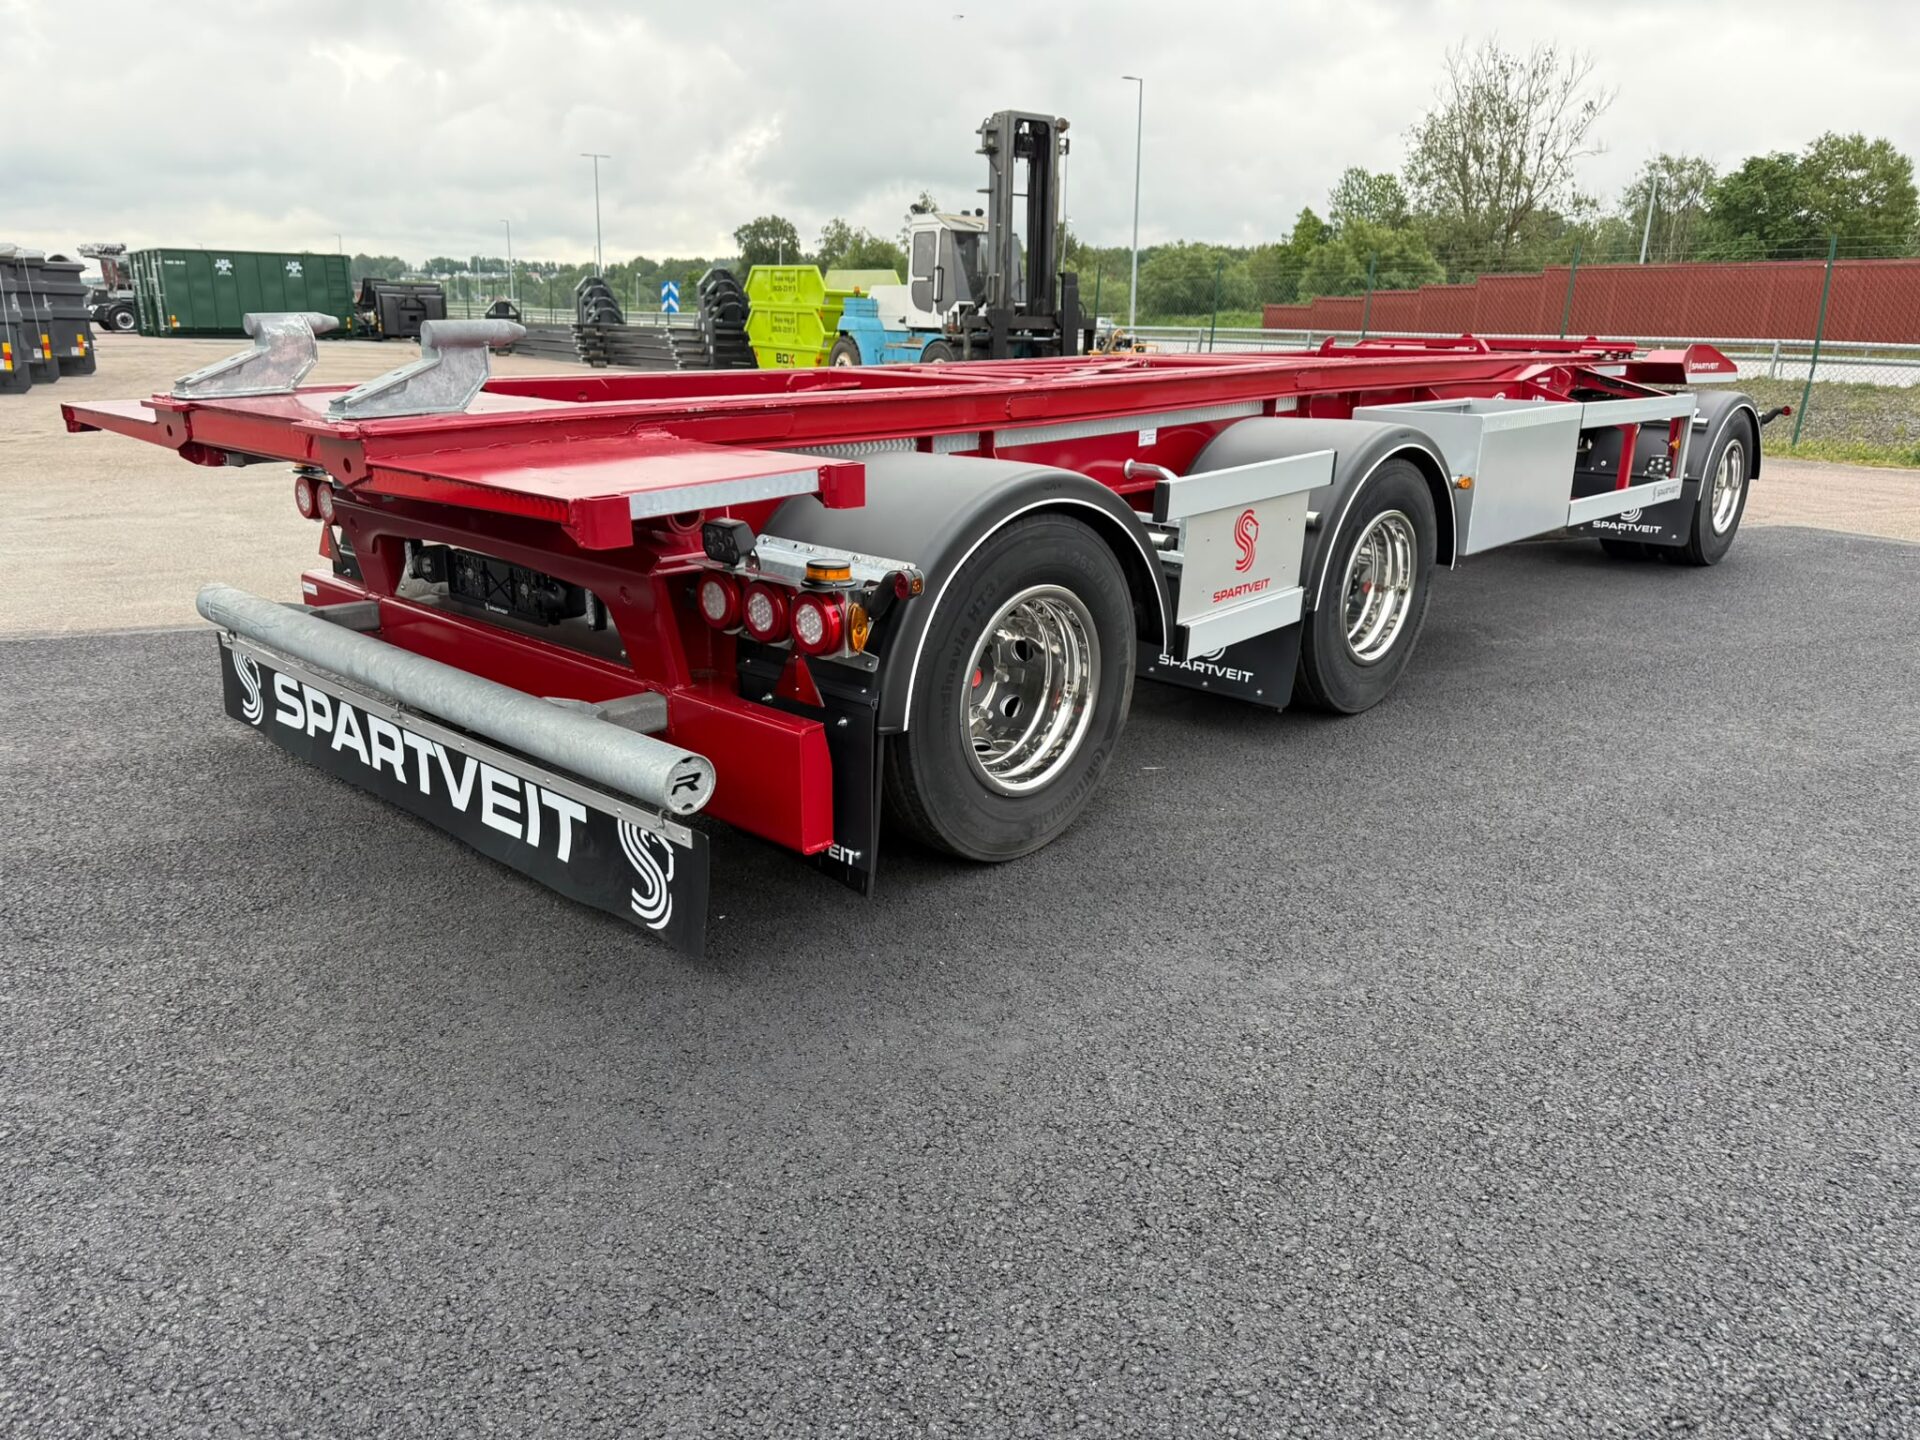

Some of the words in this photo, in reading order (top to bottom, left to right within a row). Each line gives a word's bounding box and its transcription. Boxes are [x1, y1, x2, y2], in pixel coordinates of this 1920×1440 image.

[776, 352, 795, 365] BOX
[1691, 362, 1719, 370] SPARTVEIT
[1592, 520, 1662, 534] SPARTVEIT
[1213, 578, 1271, 603] SPARTVEIT
[273, 671, 587, 864] SPARTVEIT
[826, 843, 855, 866] EIT
